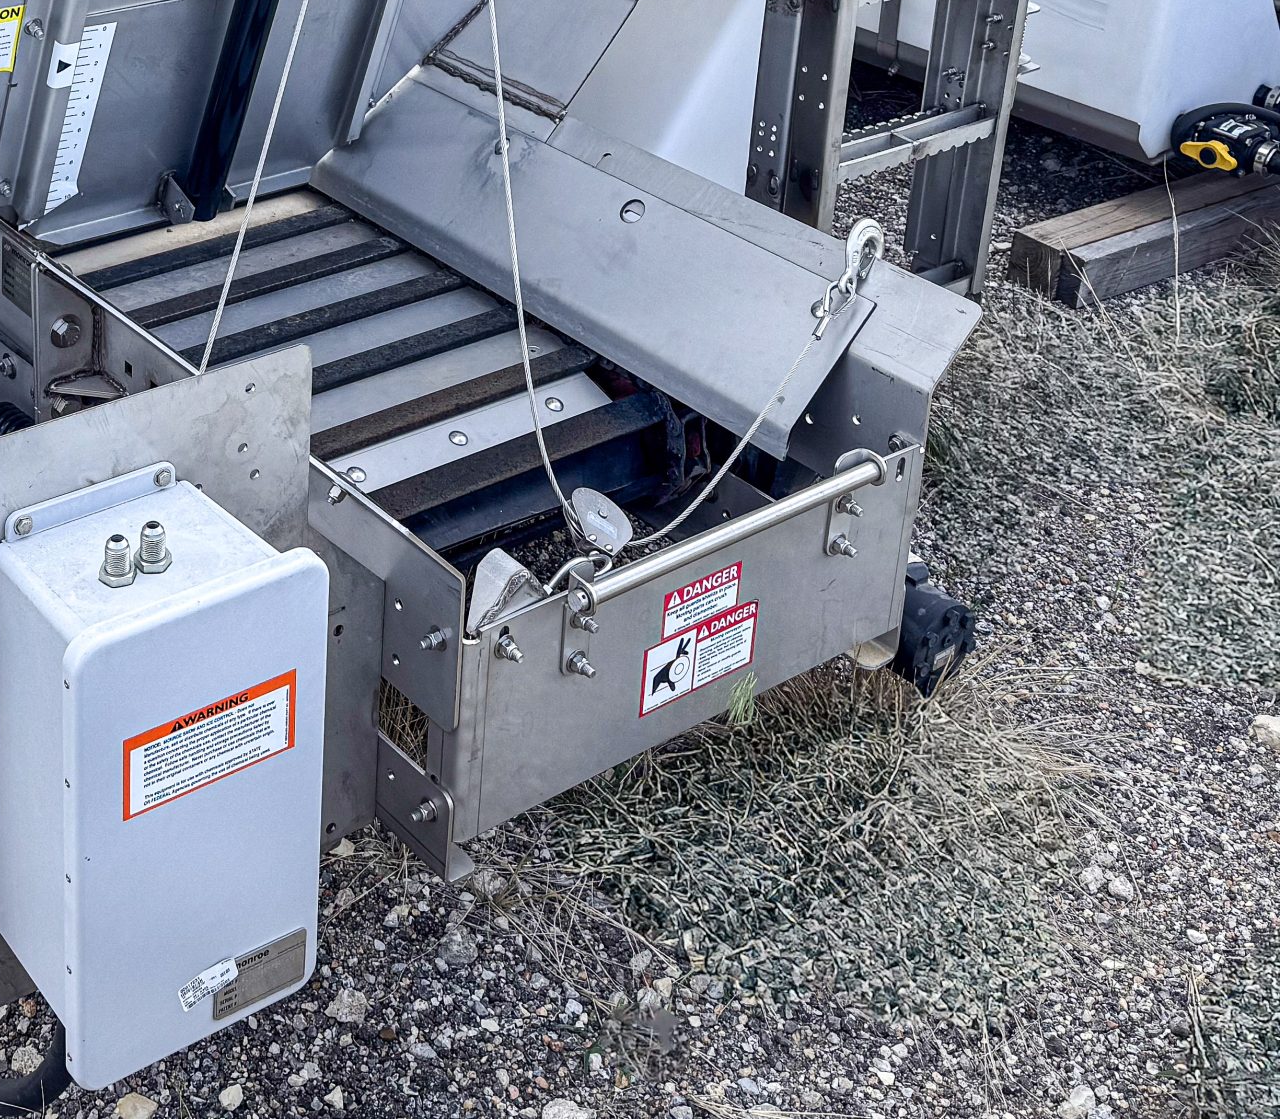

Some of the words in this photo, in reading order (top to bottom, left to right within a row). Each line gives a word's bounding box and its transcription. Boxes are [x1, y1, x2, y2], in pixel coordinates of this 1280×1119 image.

[682, 565, 738, 601] DANGER
[710, 603, 756, 633] DANGER
[182, 691, 248, 728] WARNING
